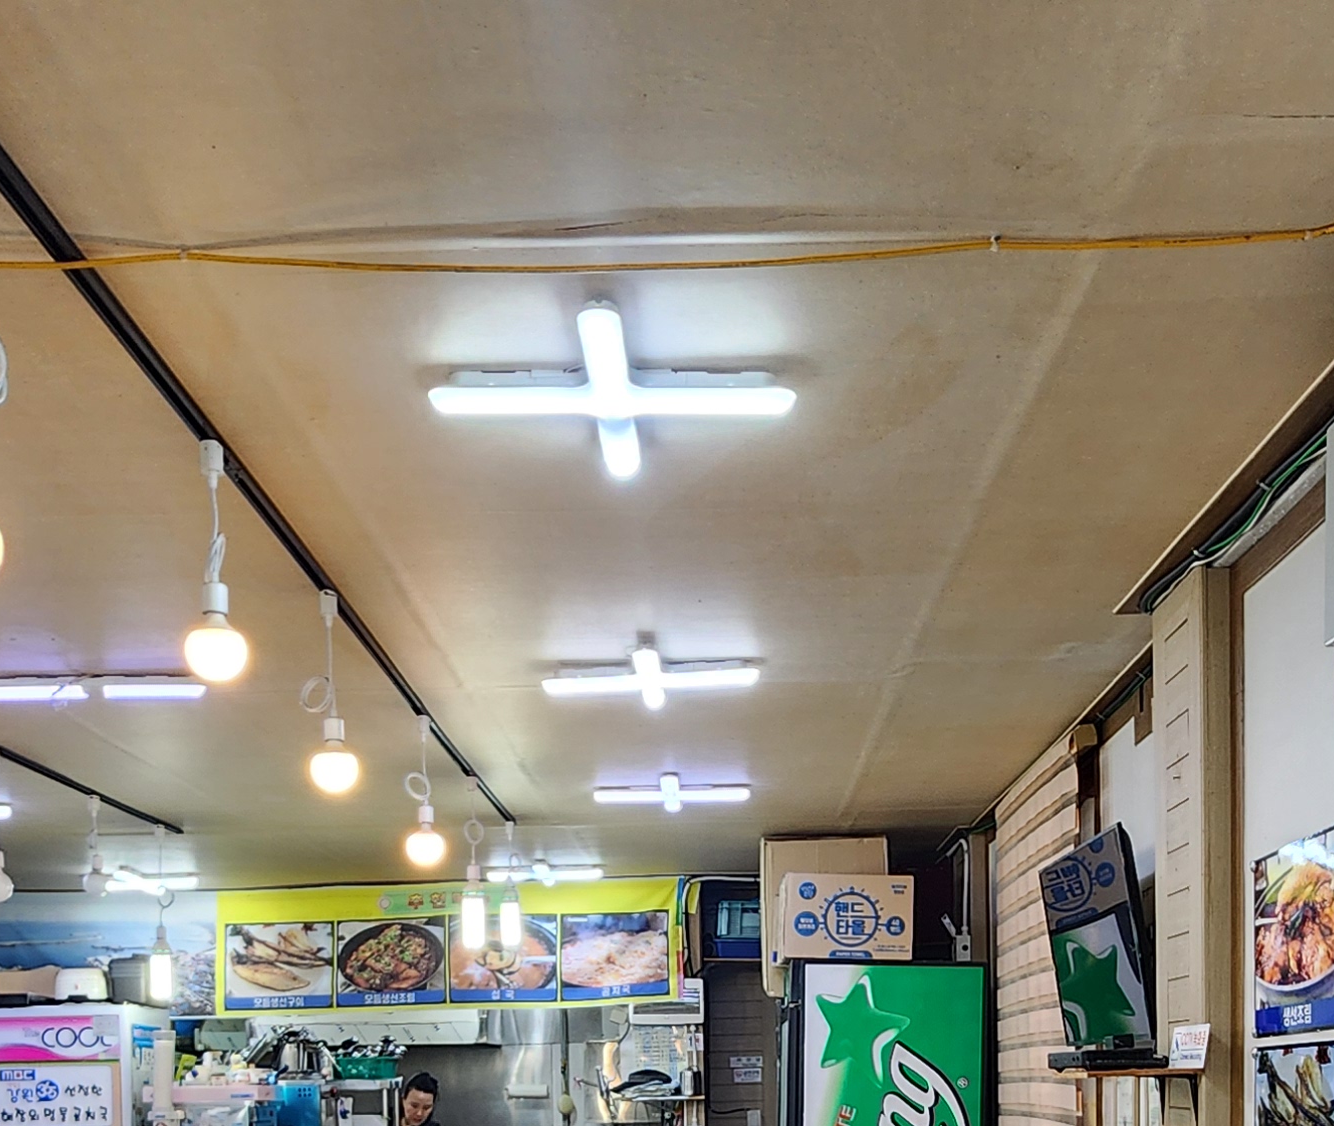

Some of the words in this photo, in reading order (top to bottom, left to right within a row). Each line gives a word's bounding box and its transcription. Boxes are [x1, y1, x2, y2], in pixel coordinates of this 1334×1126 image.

[834, 901, 871, 918] 핸드
[835, 919, 872, 936] 타올
[1283, 1003, 1312, 1027] 생선조림
[0, 1070, 35, 1081] MBC
[7, 1088, 33, 1103] 강원
